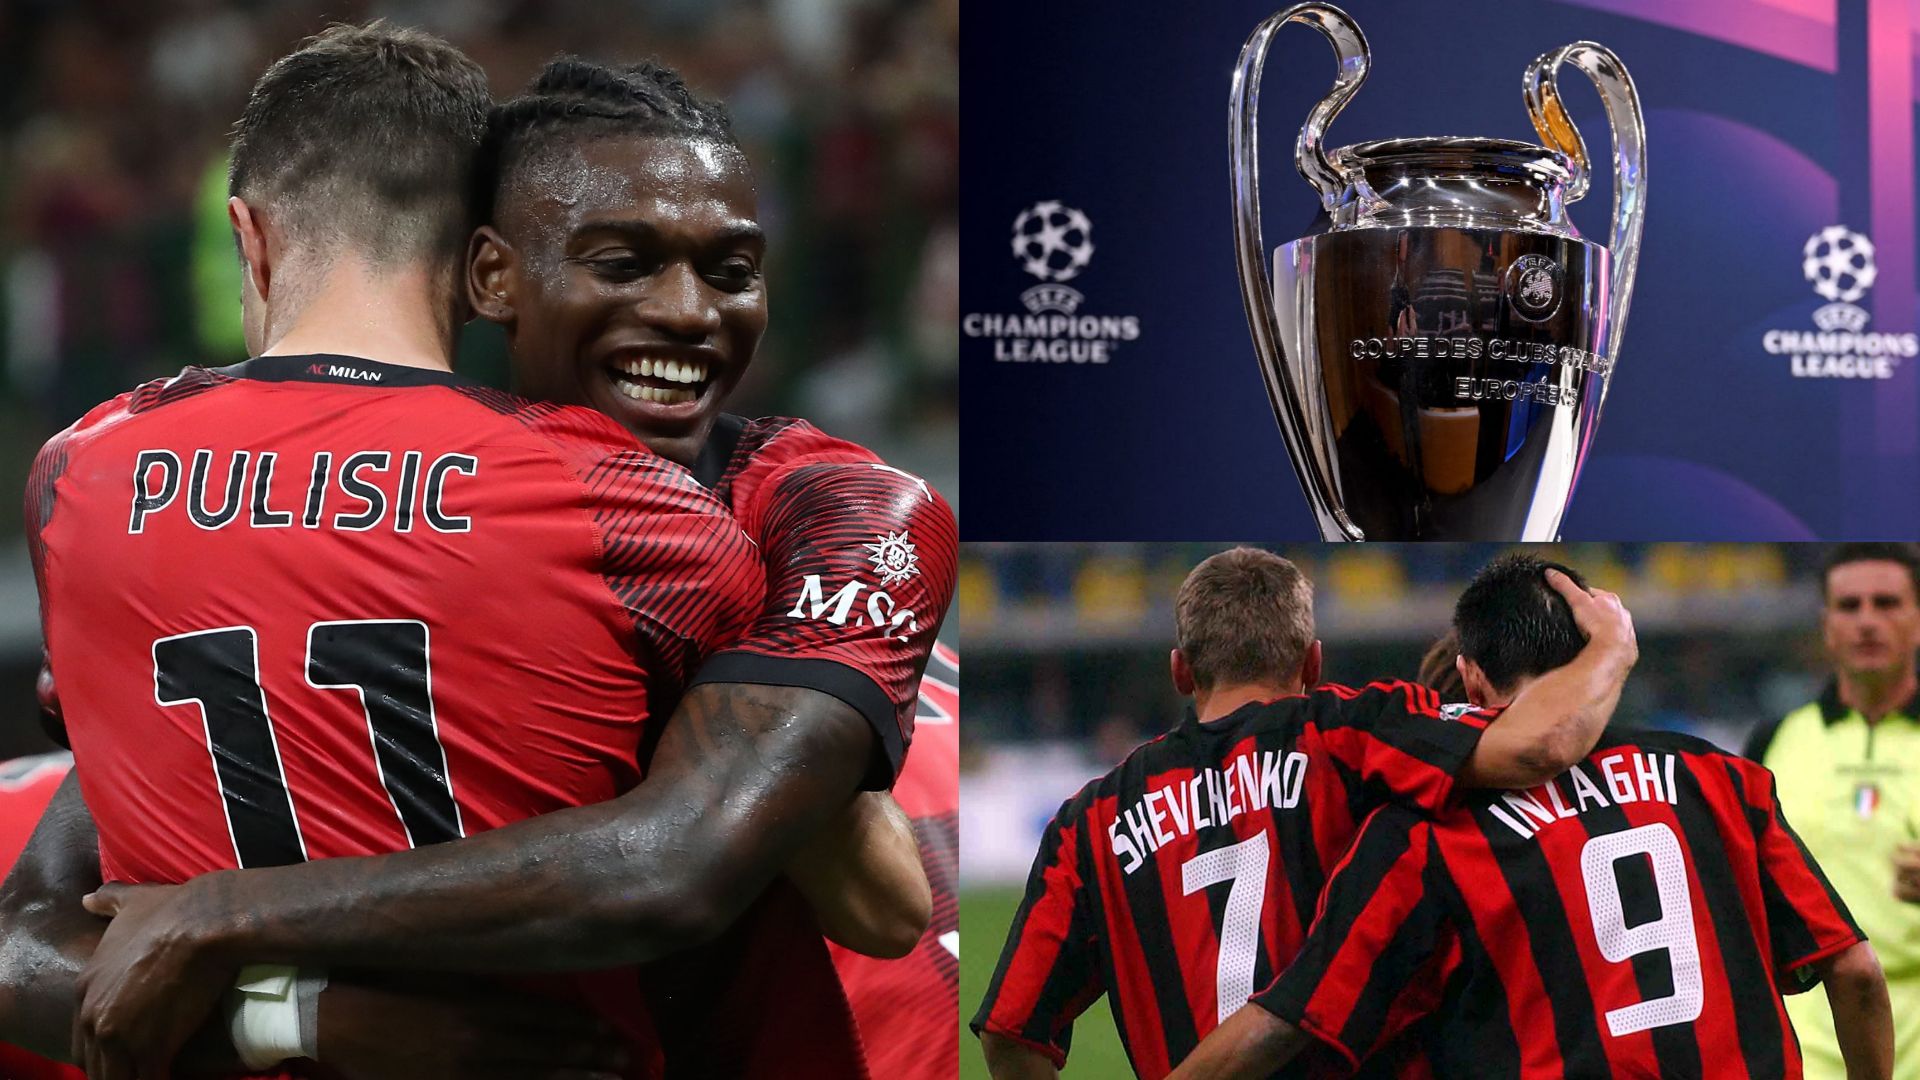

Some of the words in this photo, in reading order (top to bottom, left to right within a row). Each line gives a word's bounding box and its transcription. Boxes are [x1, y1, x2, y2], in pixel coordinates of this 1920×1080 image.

[963, 313, 1141, 340] CHAMPIONS
[994, 339, 1111, 363] LEAGUE
[1350, 337, 1429, 360] COUPE
[1435, 337, 1483, 359] DES
[1487, 338, 1557, 365] CLUBS
[1763, 330, 1918, 357] CHAMPIONS
[305, 363, 329, 376] AC
[328, 364, 382, 382] MILAN
[1791, 354, 1894, 378] LEAGUE
[128, 449, 478, 534] PULISIC
[152, 619, 466, 869] 11
[1108, 750, 1308, 875] SHEVCHENKO
[1182, 828, 1270, 1025] 7
[1580, 822, 1704, 1037] 9
